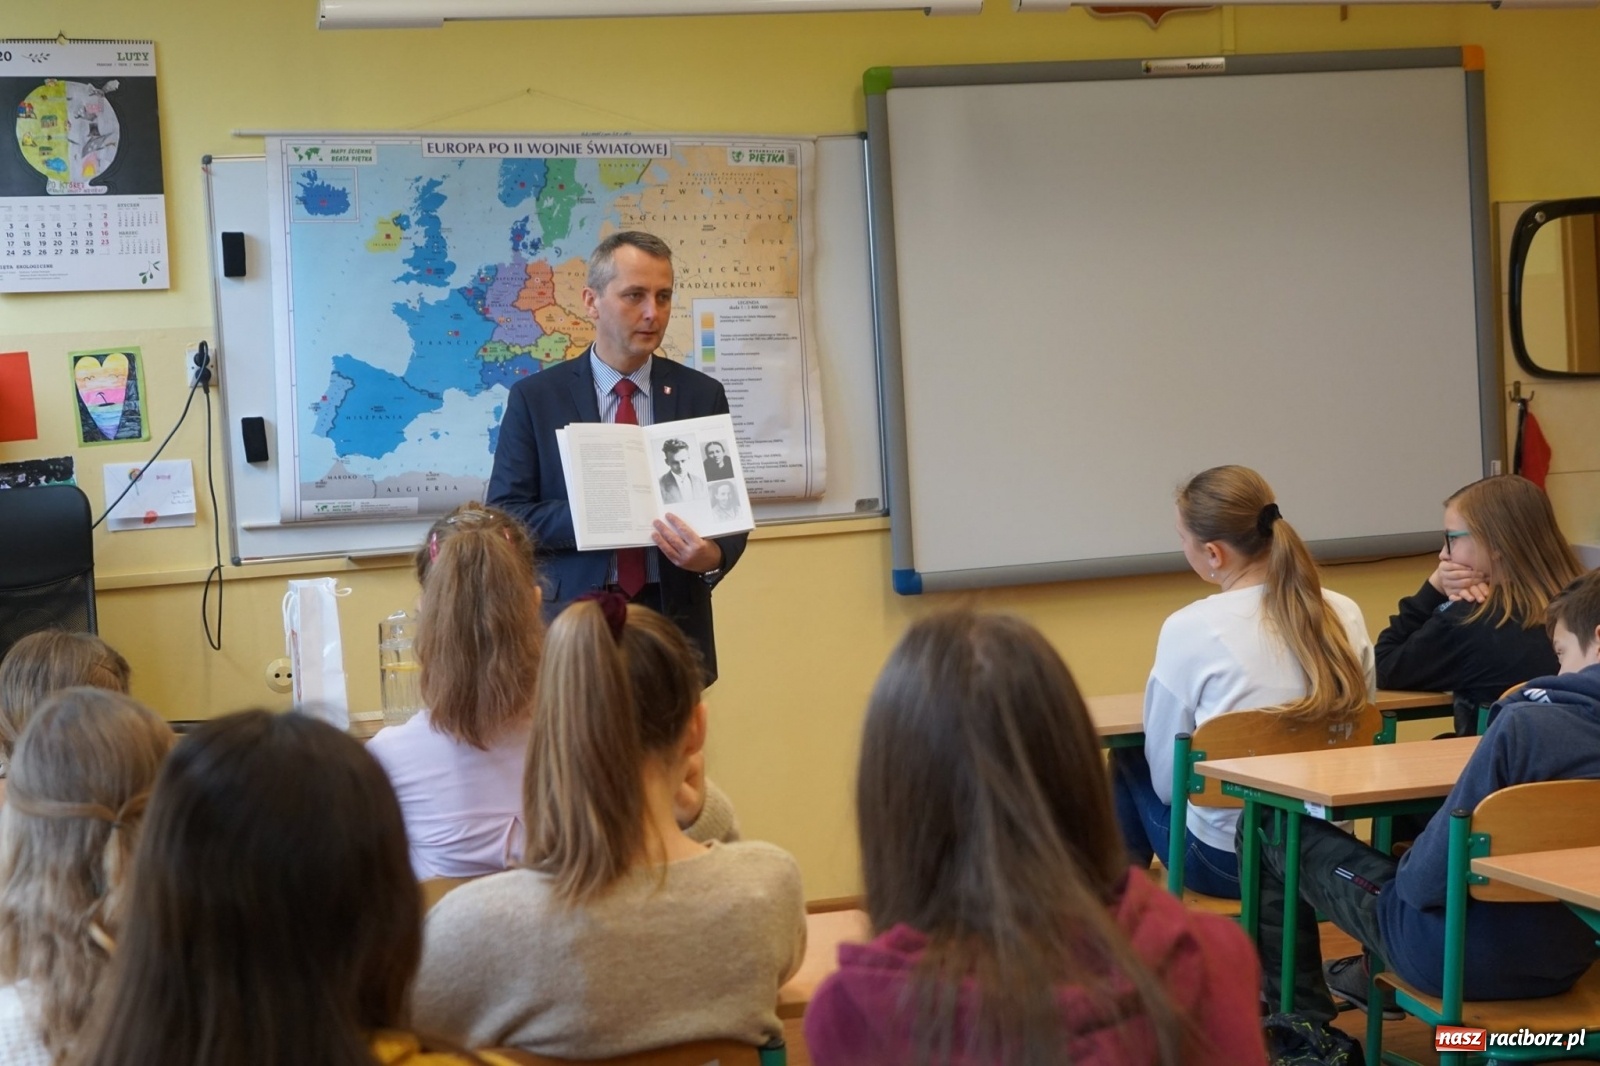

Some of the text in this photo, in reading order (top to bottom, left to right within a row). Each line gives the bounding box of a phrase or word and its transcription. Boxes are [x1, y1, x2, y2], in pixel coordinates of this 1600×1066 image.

[117, 52, 149, 61] LUTY
[427, 140, 668, 157] EUROPA PO II WOJNIE ŚWIATOWEJ
[748, 153, 785, 164] PIĘTKA
[629, 213, 793, 222] SOCJALISTYCZNYCH
[682, 265, 775, 274] WIECKICH
[386, 484, 458, 493] ALGIERIA
